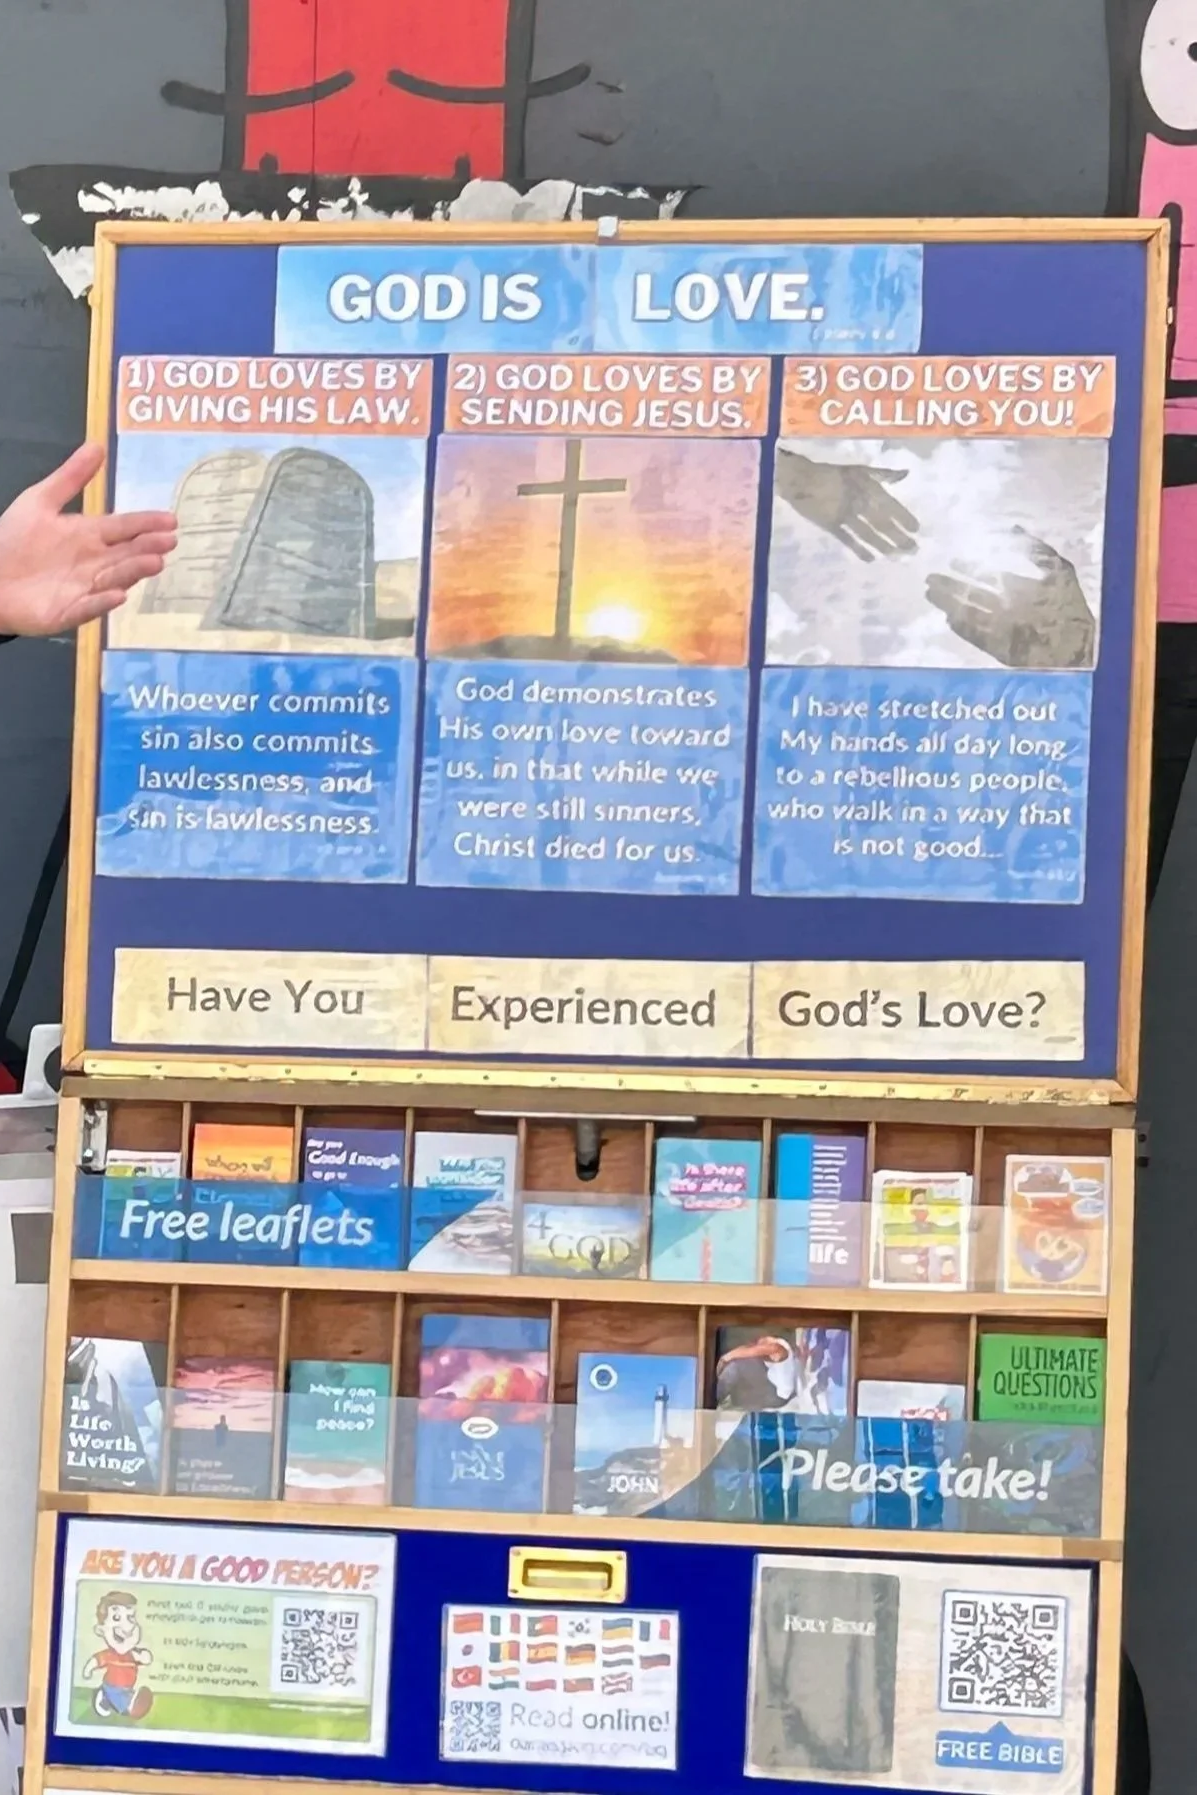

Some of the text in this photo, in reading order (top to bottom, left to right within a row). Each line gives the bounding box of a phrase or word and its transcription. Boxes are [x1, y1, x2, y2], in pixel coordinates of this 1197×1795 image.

[328, 272, 826, 323] GOD IS LOVE.
[128, 361, 423, 392] 1) GOD LOVES BY
[454, 363, 763, 395] 2) GOD LOVES BY
[793, 363, 1104, 397] 3) GOD LOVES BY
[128, 395, 421, 426] GIVING HIS LAW.
[460, 398, 753, 429] SENDING JESUS.
[819, 399, 1076, 428] CALLING YOU!
[128, 684, 391, 715] Whoever commits
[455, 677, 718, 708] God demonstrates
[790, 695, 1058, 722] I have stretched out
[141, 725, 374, 756] sin also commits
[439, 715, 731, 748] His own love toward
[780, 729, 1069, 761] My hands all day long
[138, 764, 374, 795] lawlessness, and
[493, 756, 517, 781] in
[526, 758, 583, 782] that
[591, 760, 669, 785] while
[675, 766, 721, 787] we
[775, 765, 804, 786] to
[809, 768, 826, 787] a
[833, 766, 962, 789] rebellious
[128, 804, 380, 835] sin is lawlessness.
[457, 797, 702, 828] were still sinners,
[766, 796, 1073, 831] who walk in a way that
[453, 832, 701, 864] Christ died for us.
[832, 836, 854, 856] is
[861, 834, 905, 857] not
[167, 976, 1048, 1030] Have You Experienced God's Love?
[307, 1150, 401, 1169] Good Enough
[119, 1199, 375, 1251] Free leaflets
[1011, 1345, 1099, 1373] ULTIMATE
[993, 1370, 1097, 1400] QUESTIONS
[70, 1413, 113, 1431] Life
[68, 1431, 138, 1452] Worth
[66, 1450, 146, 1474] Living?
[781, 1448, 1052, 1502] Please take!
[606, 1473, 660, 1494] JOHN
[80, 1549, 382, 1591] ARE YOU A GOOD PERSON?
[510, 1702, 670, 1733] Read online!
[937, 1739, 1063, 1766] FREE BIBLE
